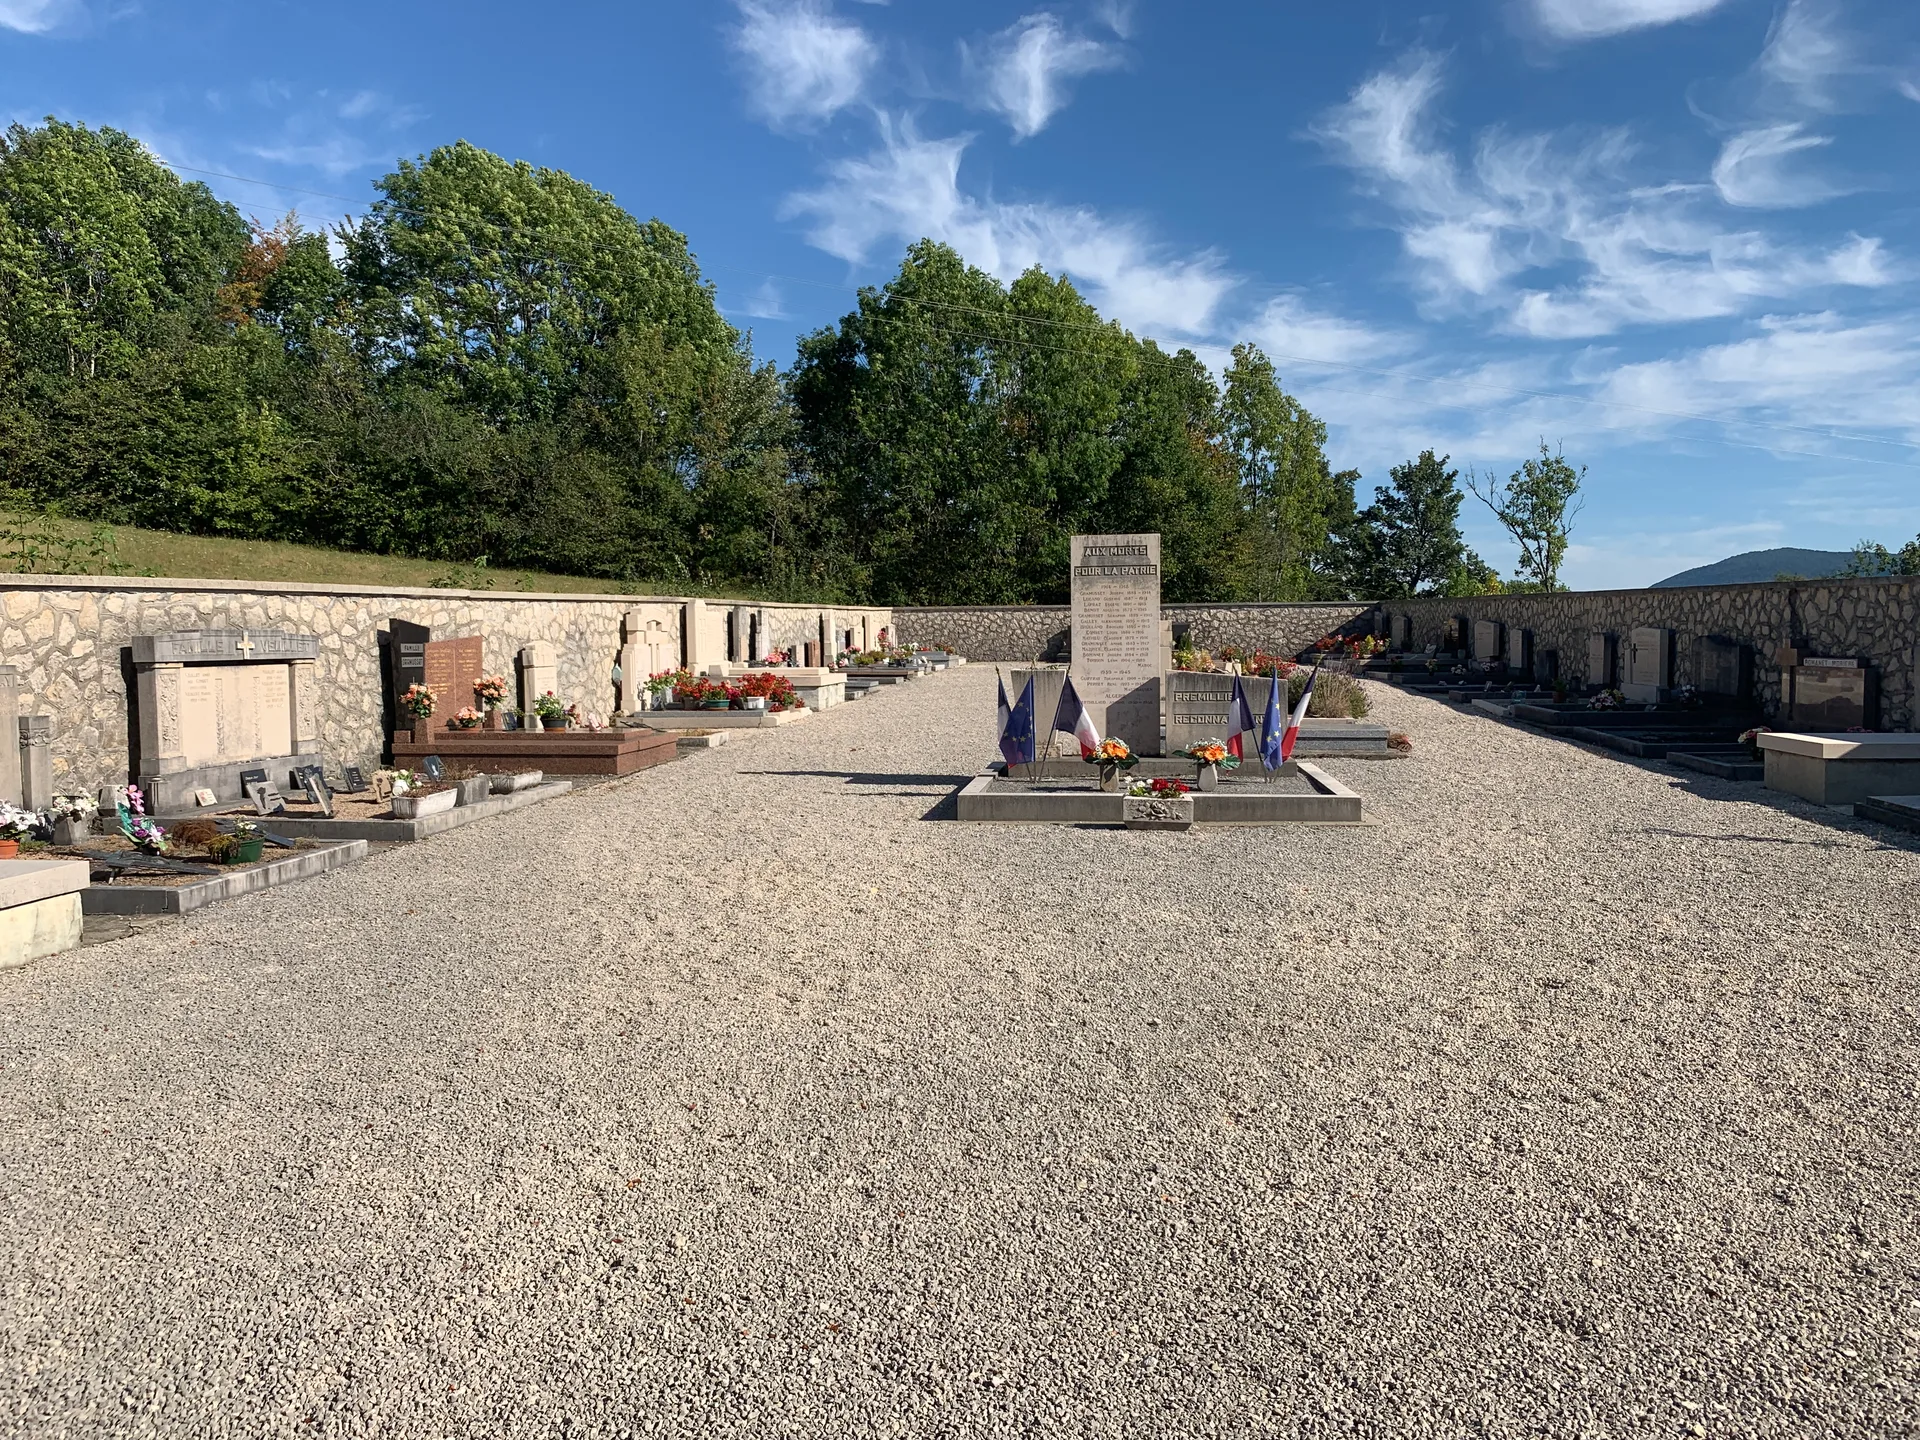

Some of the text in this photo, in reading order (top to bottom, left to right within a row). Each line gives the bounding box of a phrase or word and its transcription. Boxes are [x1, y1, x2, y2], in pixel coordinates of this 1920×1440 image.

[1084, 546, 1147, 557] AUX MORTS
[1074, 565, 1157, 577] POUR LA PATRIE
[172, 640, 224, 655] FAMILLE
[1173, 691, 1234, 703] PREMILLIE
